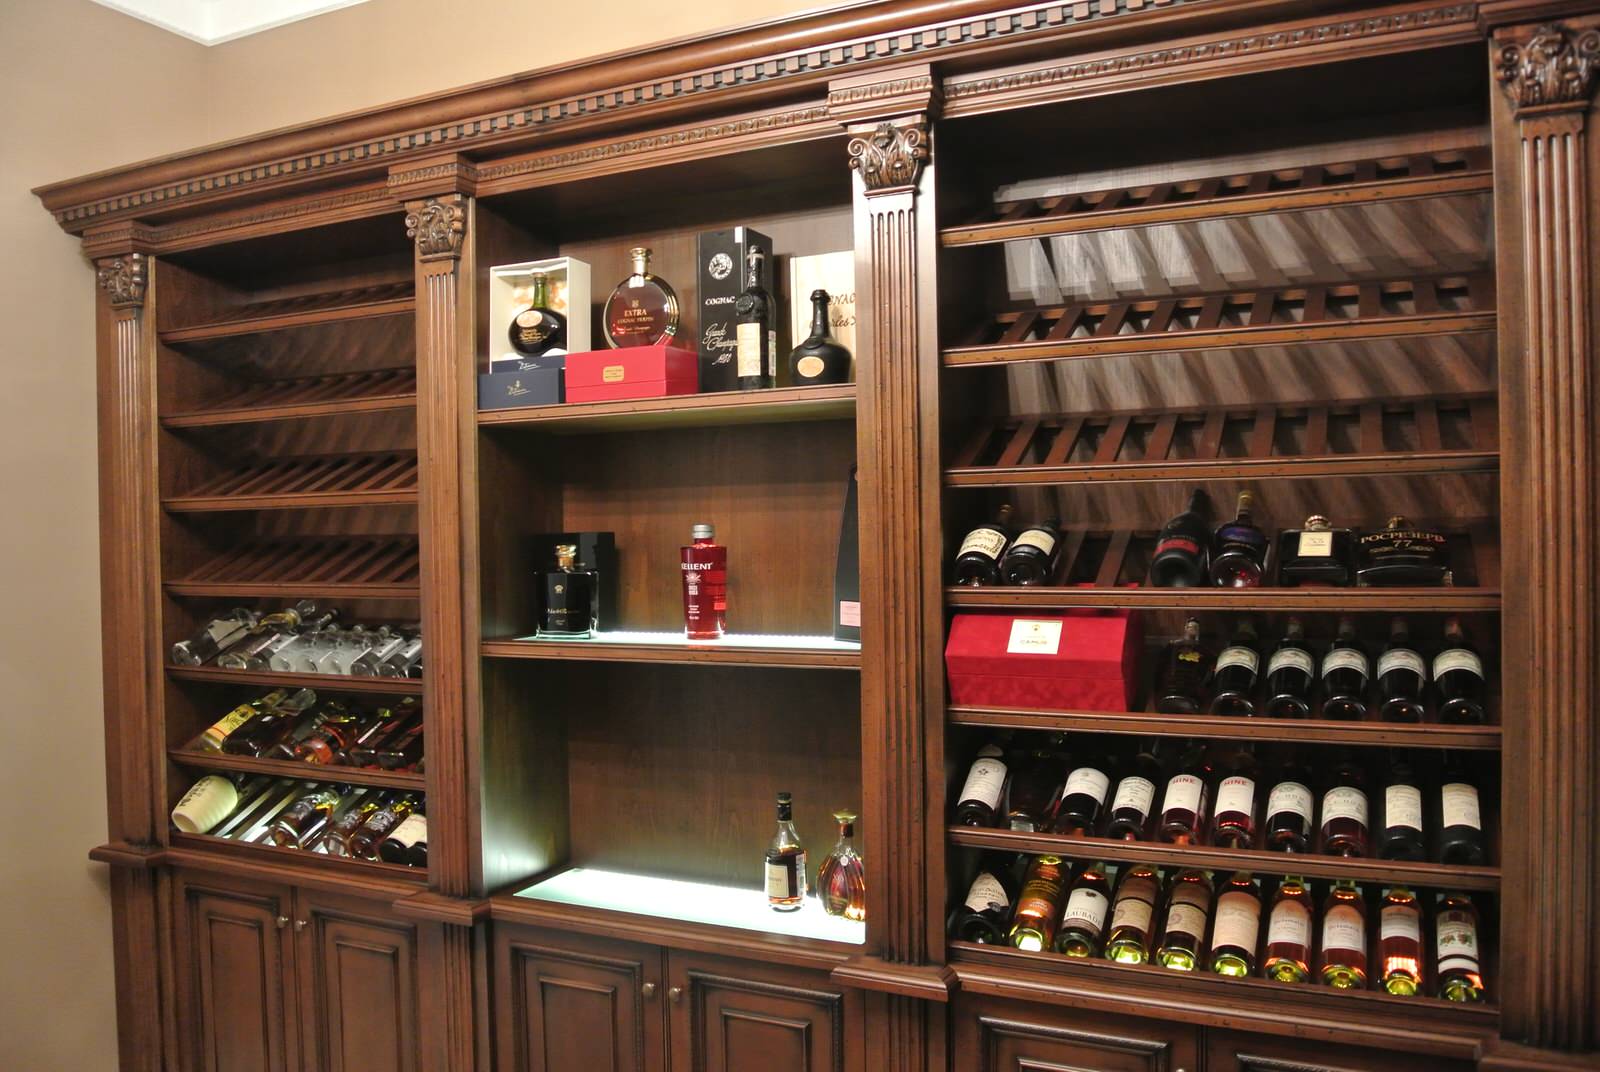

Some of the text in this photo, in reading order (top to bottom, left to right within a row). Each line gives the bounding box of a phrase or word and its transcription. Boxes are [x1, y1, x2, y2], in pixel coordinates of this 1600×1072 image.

[705, 295, 736, 306] COGNAC
[624, 308, 647, 317] EXTRA
[1393, 539, 1413, 548] 77
